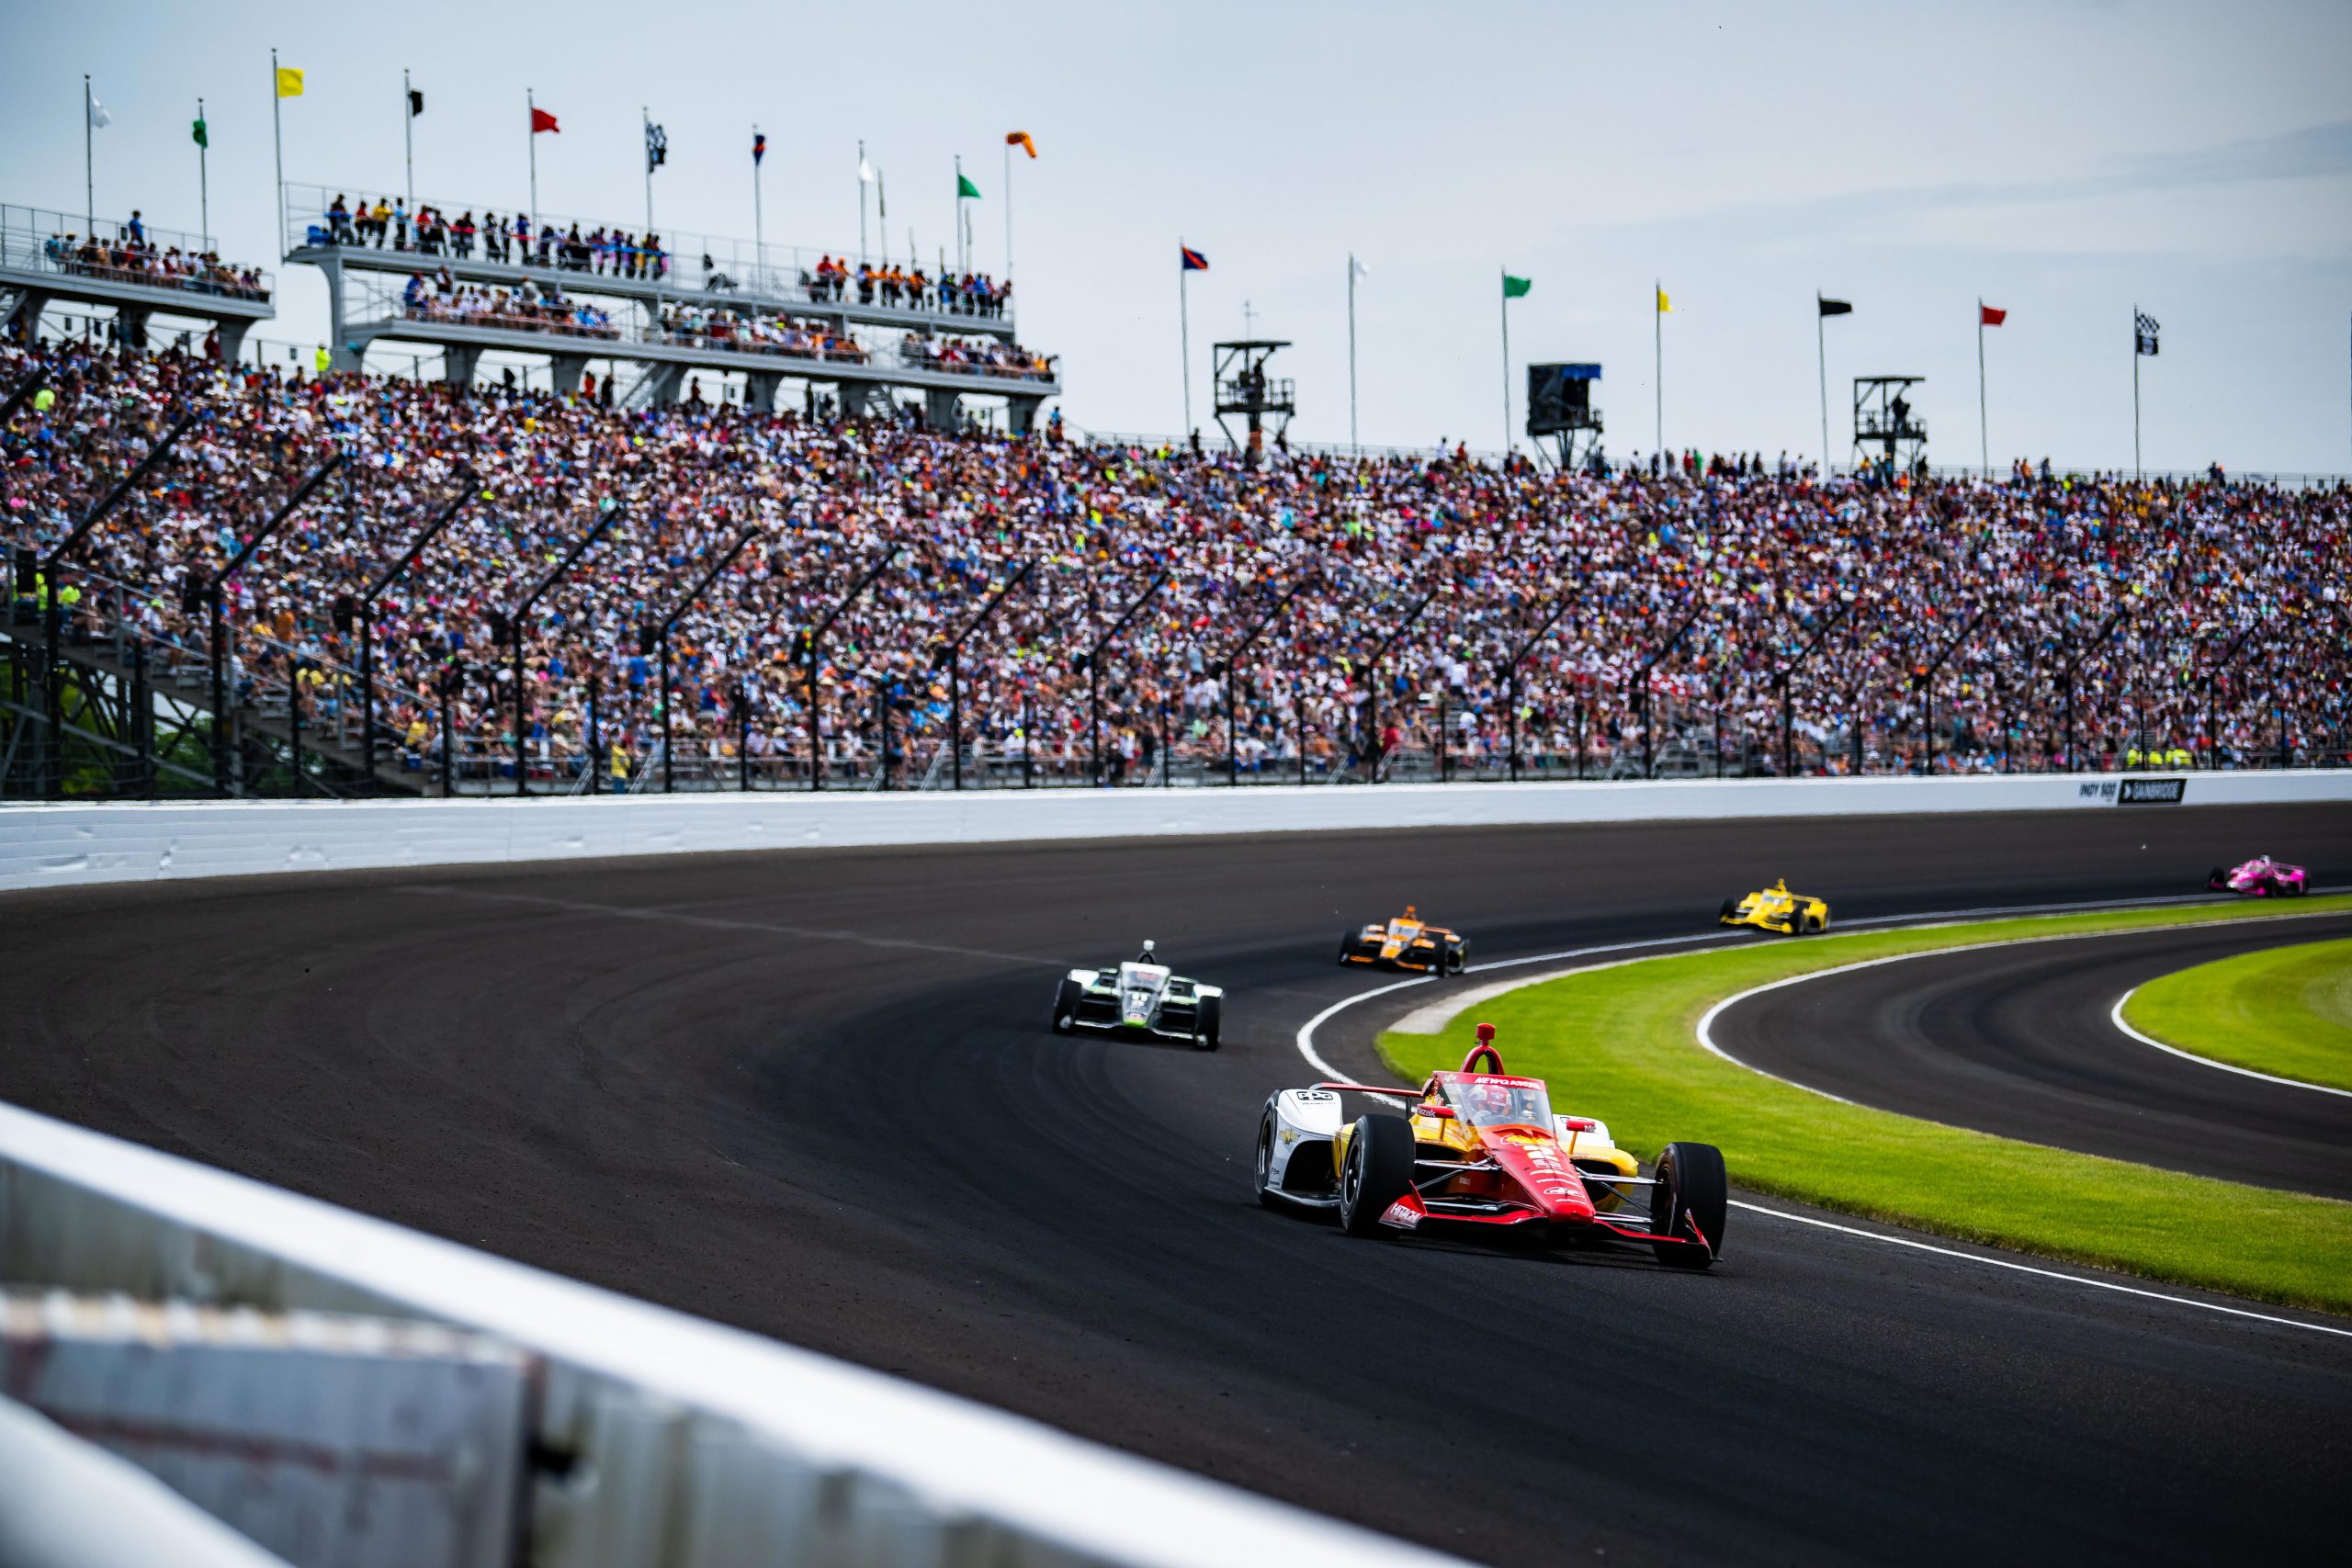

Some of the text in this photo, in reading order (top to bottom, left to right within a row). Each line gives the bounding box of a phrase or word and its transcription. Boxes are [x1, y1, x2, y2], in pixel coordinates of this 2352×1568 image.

[2079, 783, 2099, 796] INDY
[1296, 1090, 1334, 1100] PPG
[1389, 1202, 1421, 1224] HITACHI
